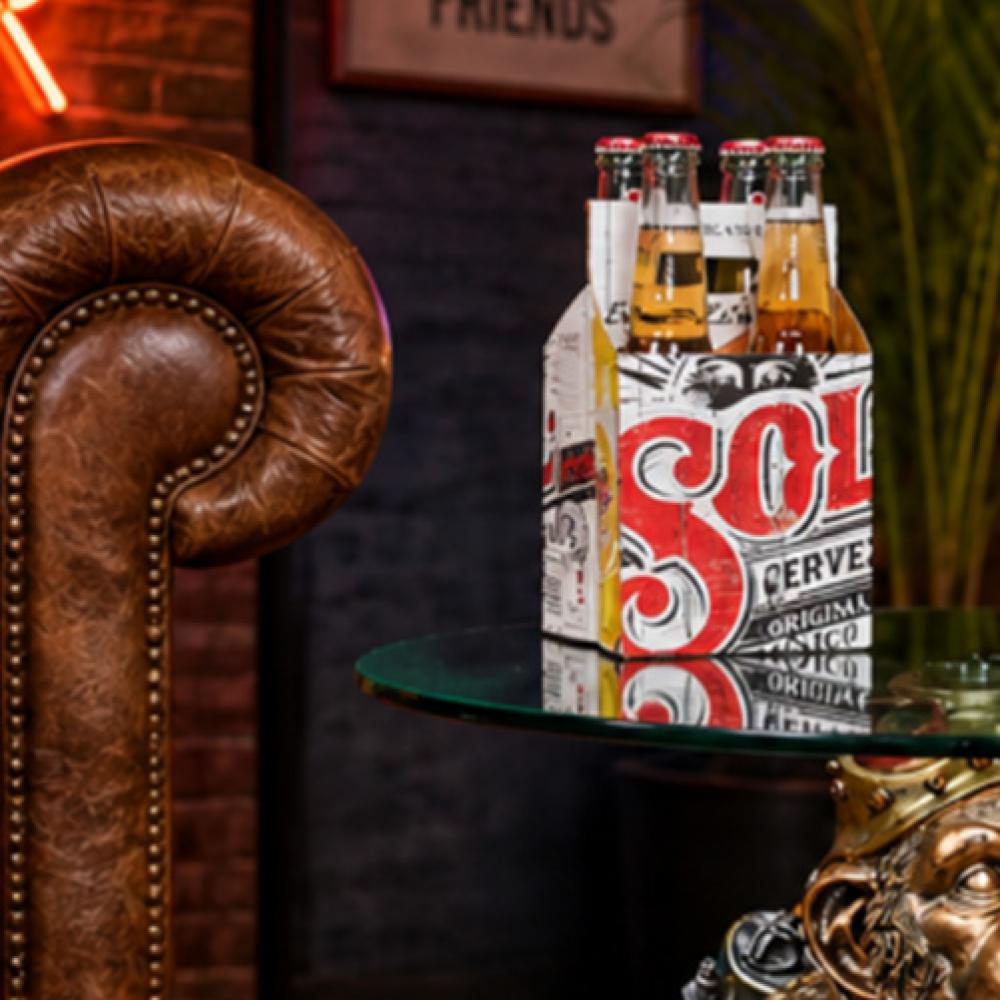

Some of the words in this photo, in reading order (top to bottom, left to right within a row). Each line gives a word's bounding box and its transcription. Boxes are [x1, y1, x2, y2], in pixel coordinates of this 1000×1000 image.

[428, 0, 618, 45] FRIENDS
[618, 386, 872, 657] SOL
[763, 537, 872, 596] CERVE
